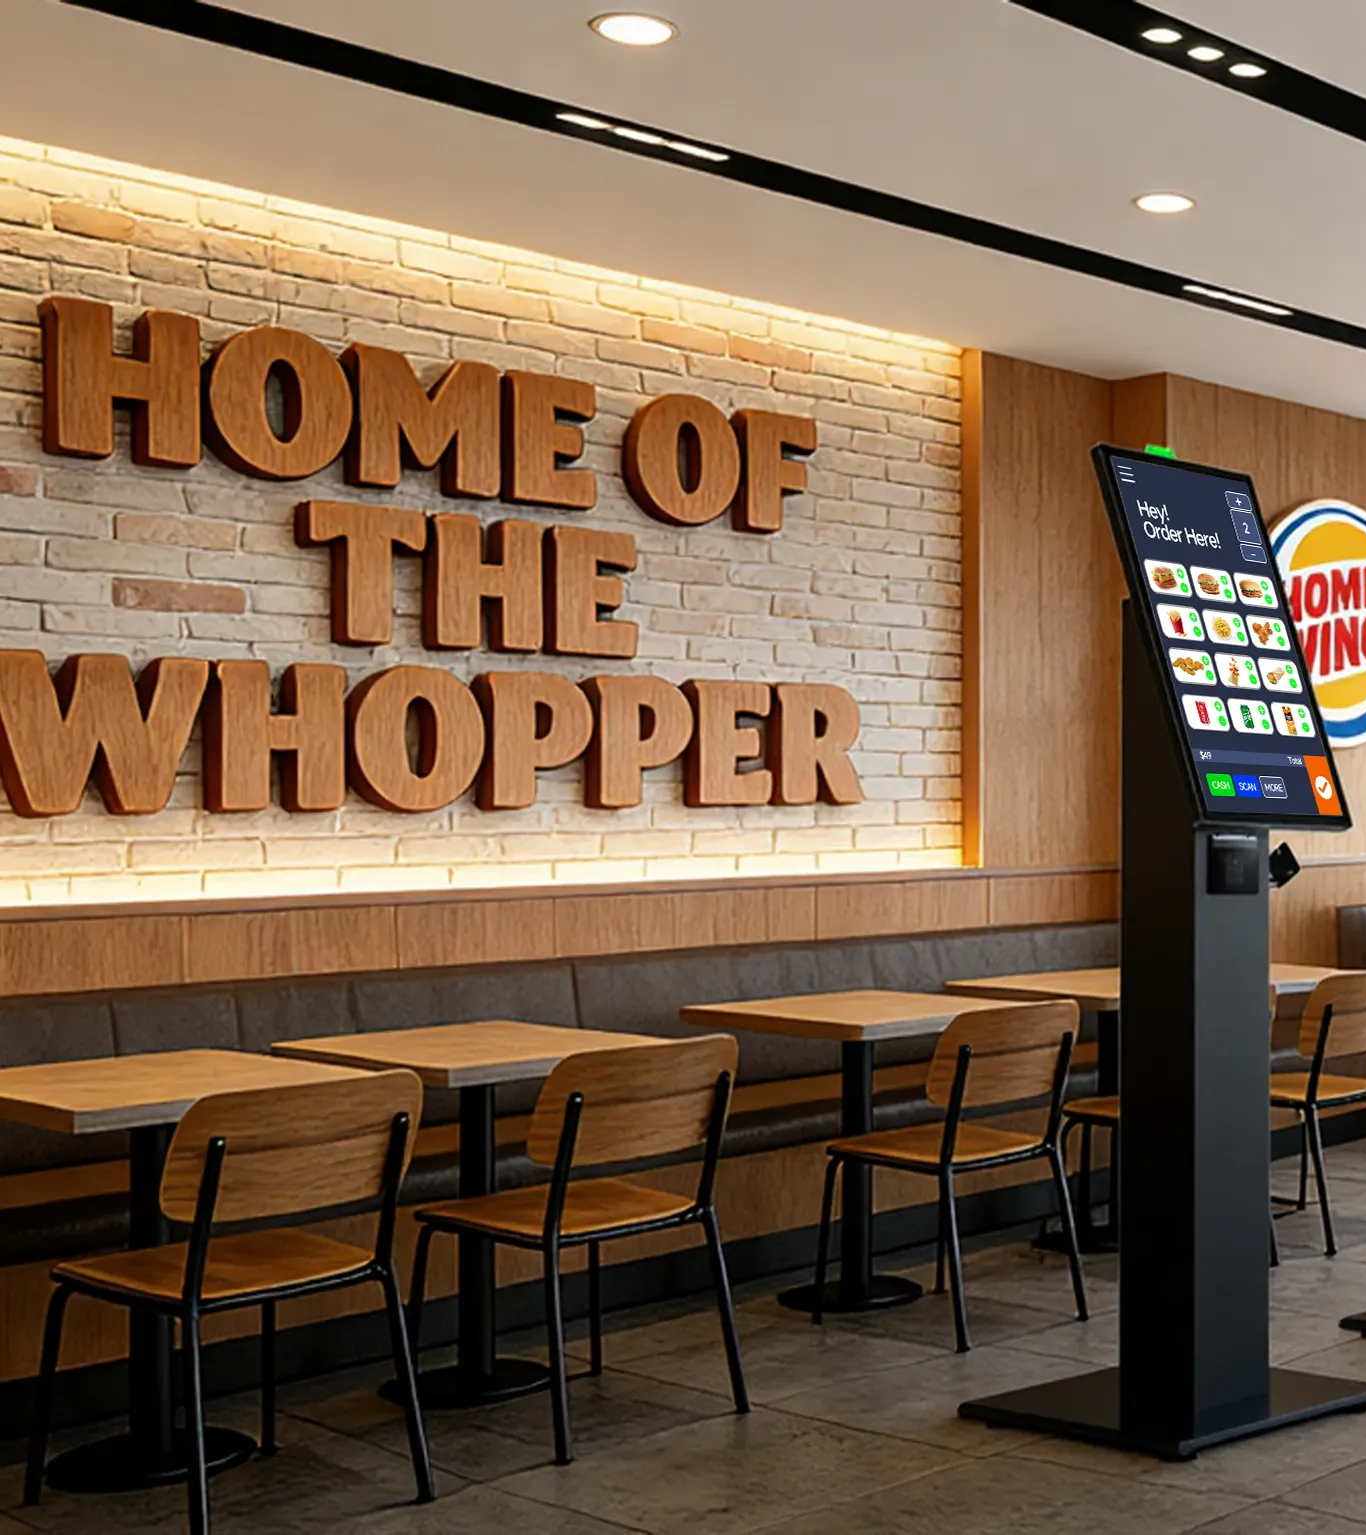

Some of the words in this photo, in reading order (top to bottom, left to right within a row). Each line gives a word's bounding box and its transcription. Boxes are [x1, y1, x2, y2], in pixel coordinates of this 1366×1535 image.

[37, 296, 597, 509] HOME
[622, 393, 817, 534] OF
[1136, 499, 1171, 525] Hey!
[1143, 520, 1183, 543] Order
[1184, 527, 1222, 550] Here!
[1242, 522, 1251, 535] 2
[294, 500, 639, 659] THE
[0, 649, 863, 818] WHOPPER
[1199, 750, 1212, 760] $49
[1211, 780, 1231, 791] CASH
[1238, 782, 1258, 792] SCAN
[1264, 783, 1285, 793] MORE
